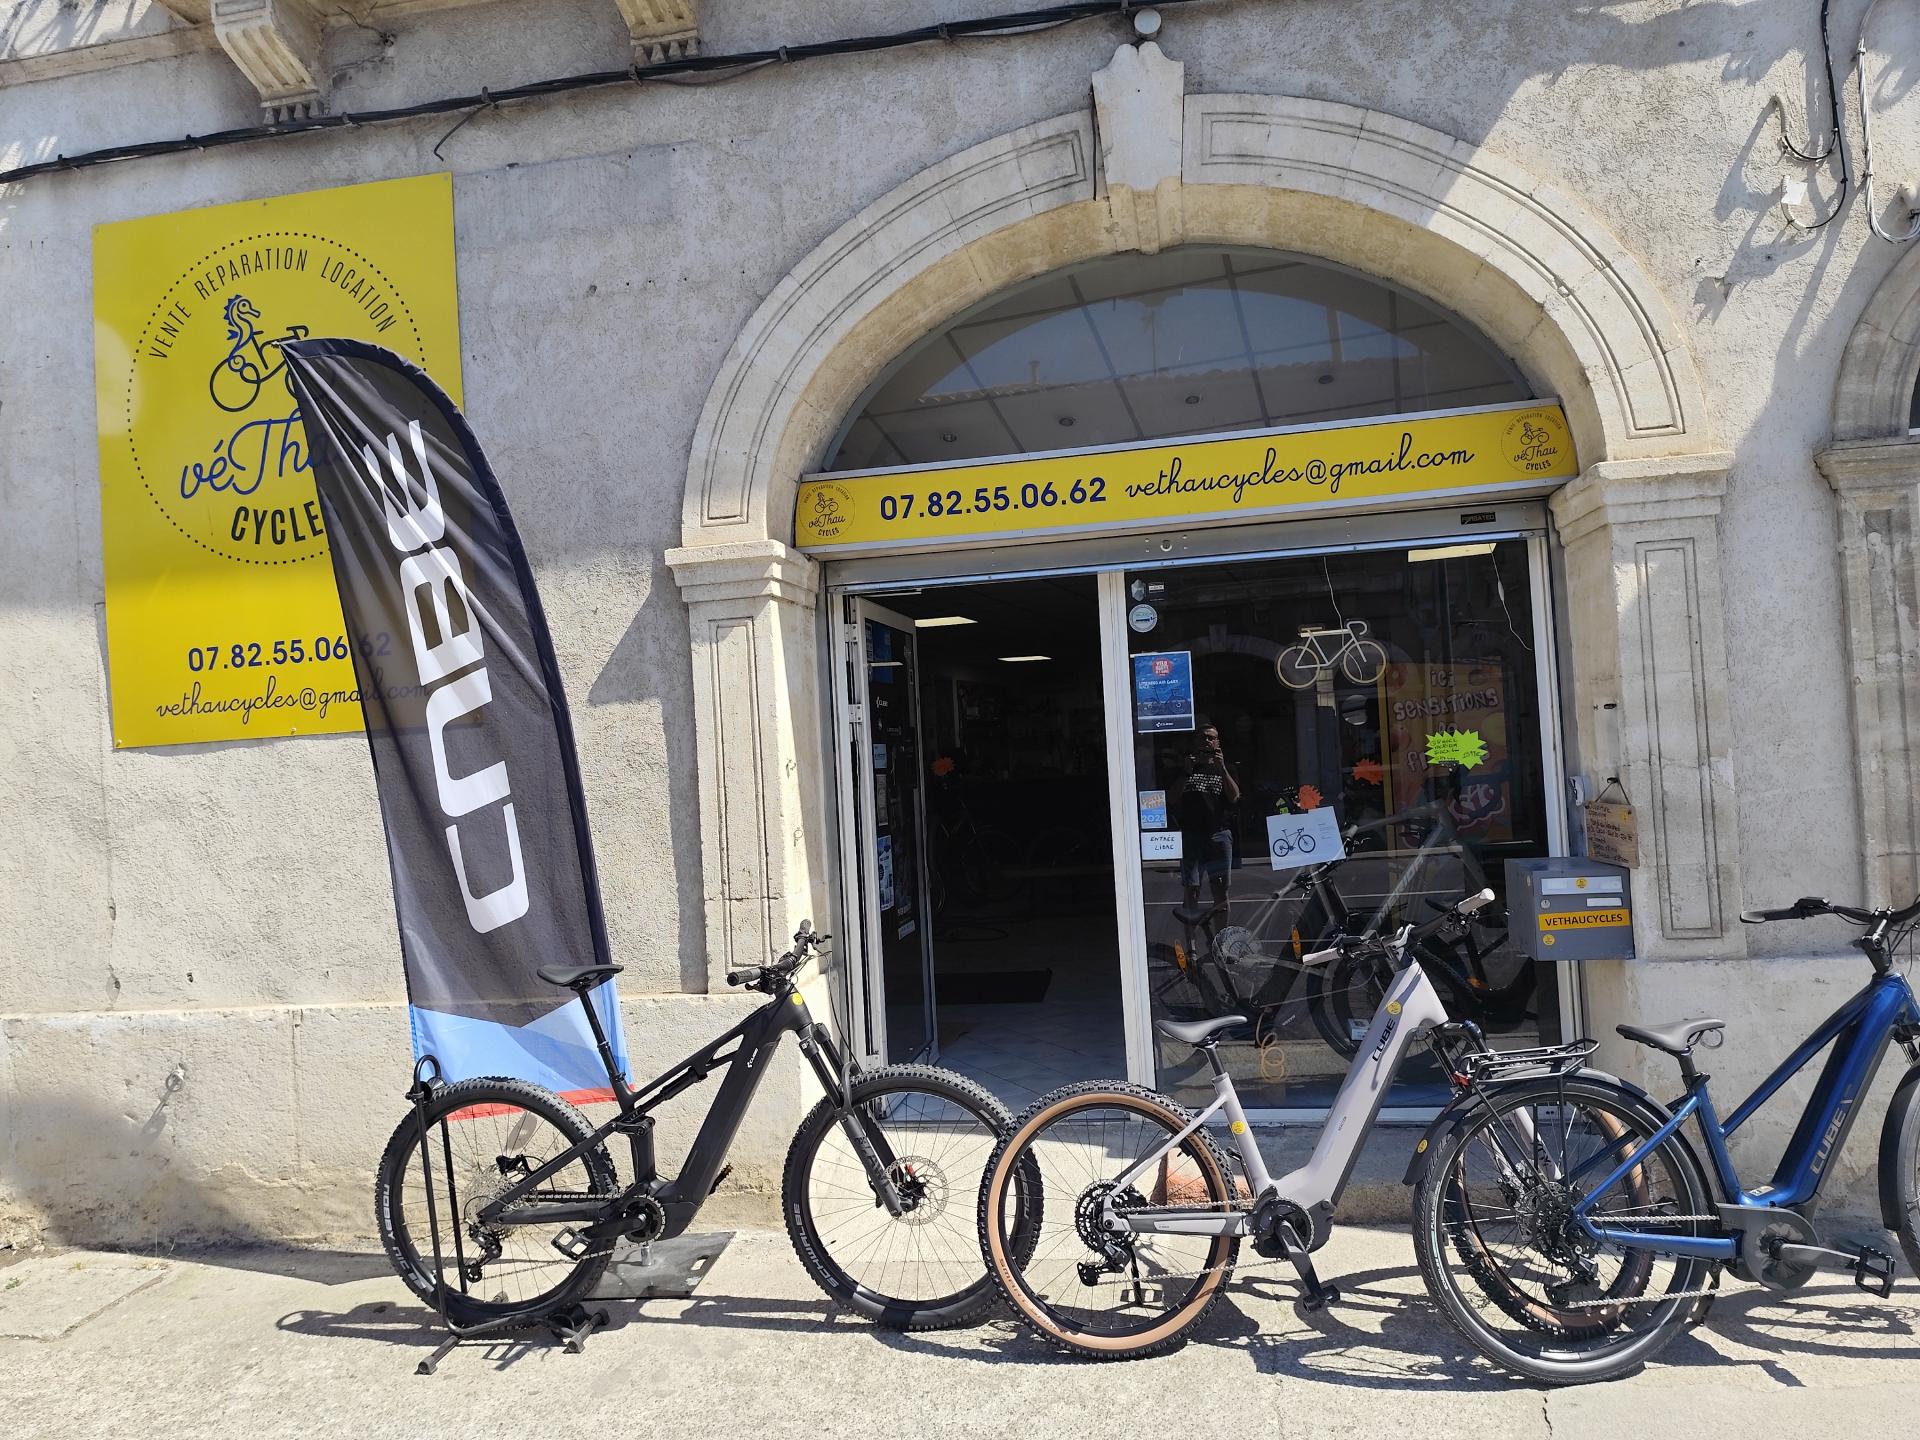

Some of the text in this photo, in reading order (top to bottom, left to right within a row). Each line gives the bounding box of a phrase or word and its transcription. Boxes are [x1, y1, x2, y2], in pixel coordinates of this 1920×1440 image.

[148, 247, 398, 359] VENTE REPARATION LOCATION
[880, 432, 1475, 521] 07.82.55.06.62 vethaucycles@gmail.com
[1525, 459, 1552, 471] CYCLES
[230, 500, 324, 545] CYCLE
[817, 527, 840, 537] CYCLES
[363, 419, 530, 934] CUBE
[1544, 913, 1623, 927] VETHAUCYCLES
[1371, 1017, 1396, 1062] CUBE
[1809, 1107, 1847, 1176] CUBE
[382, 1183, 396, 1240] NOBBY
[793, 1202, 840, 1288] SCHWALBE
